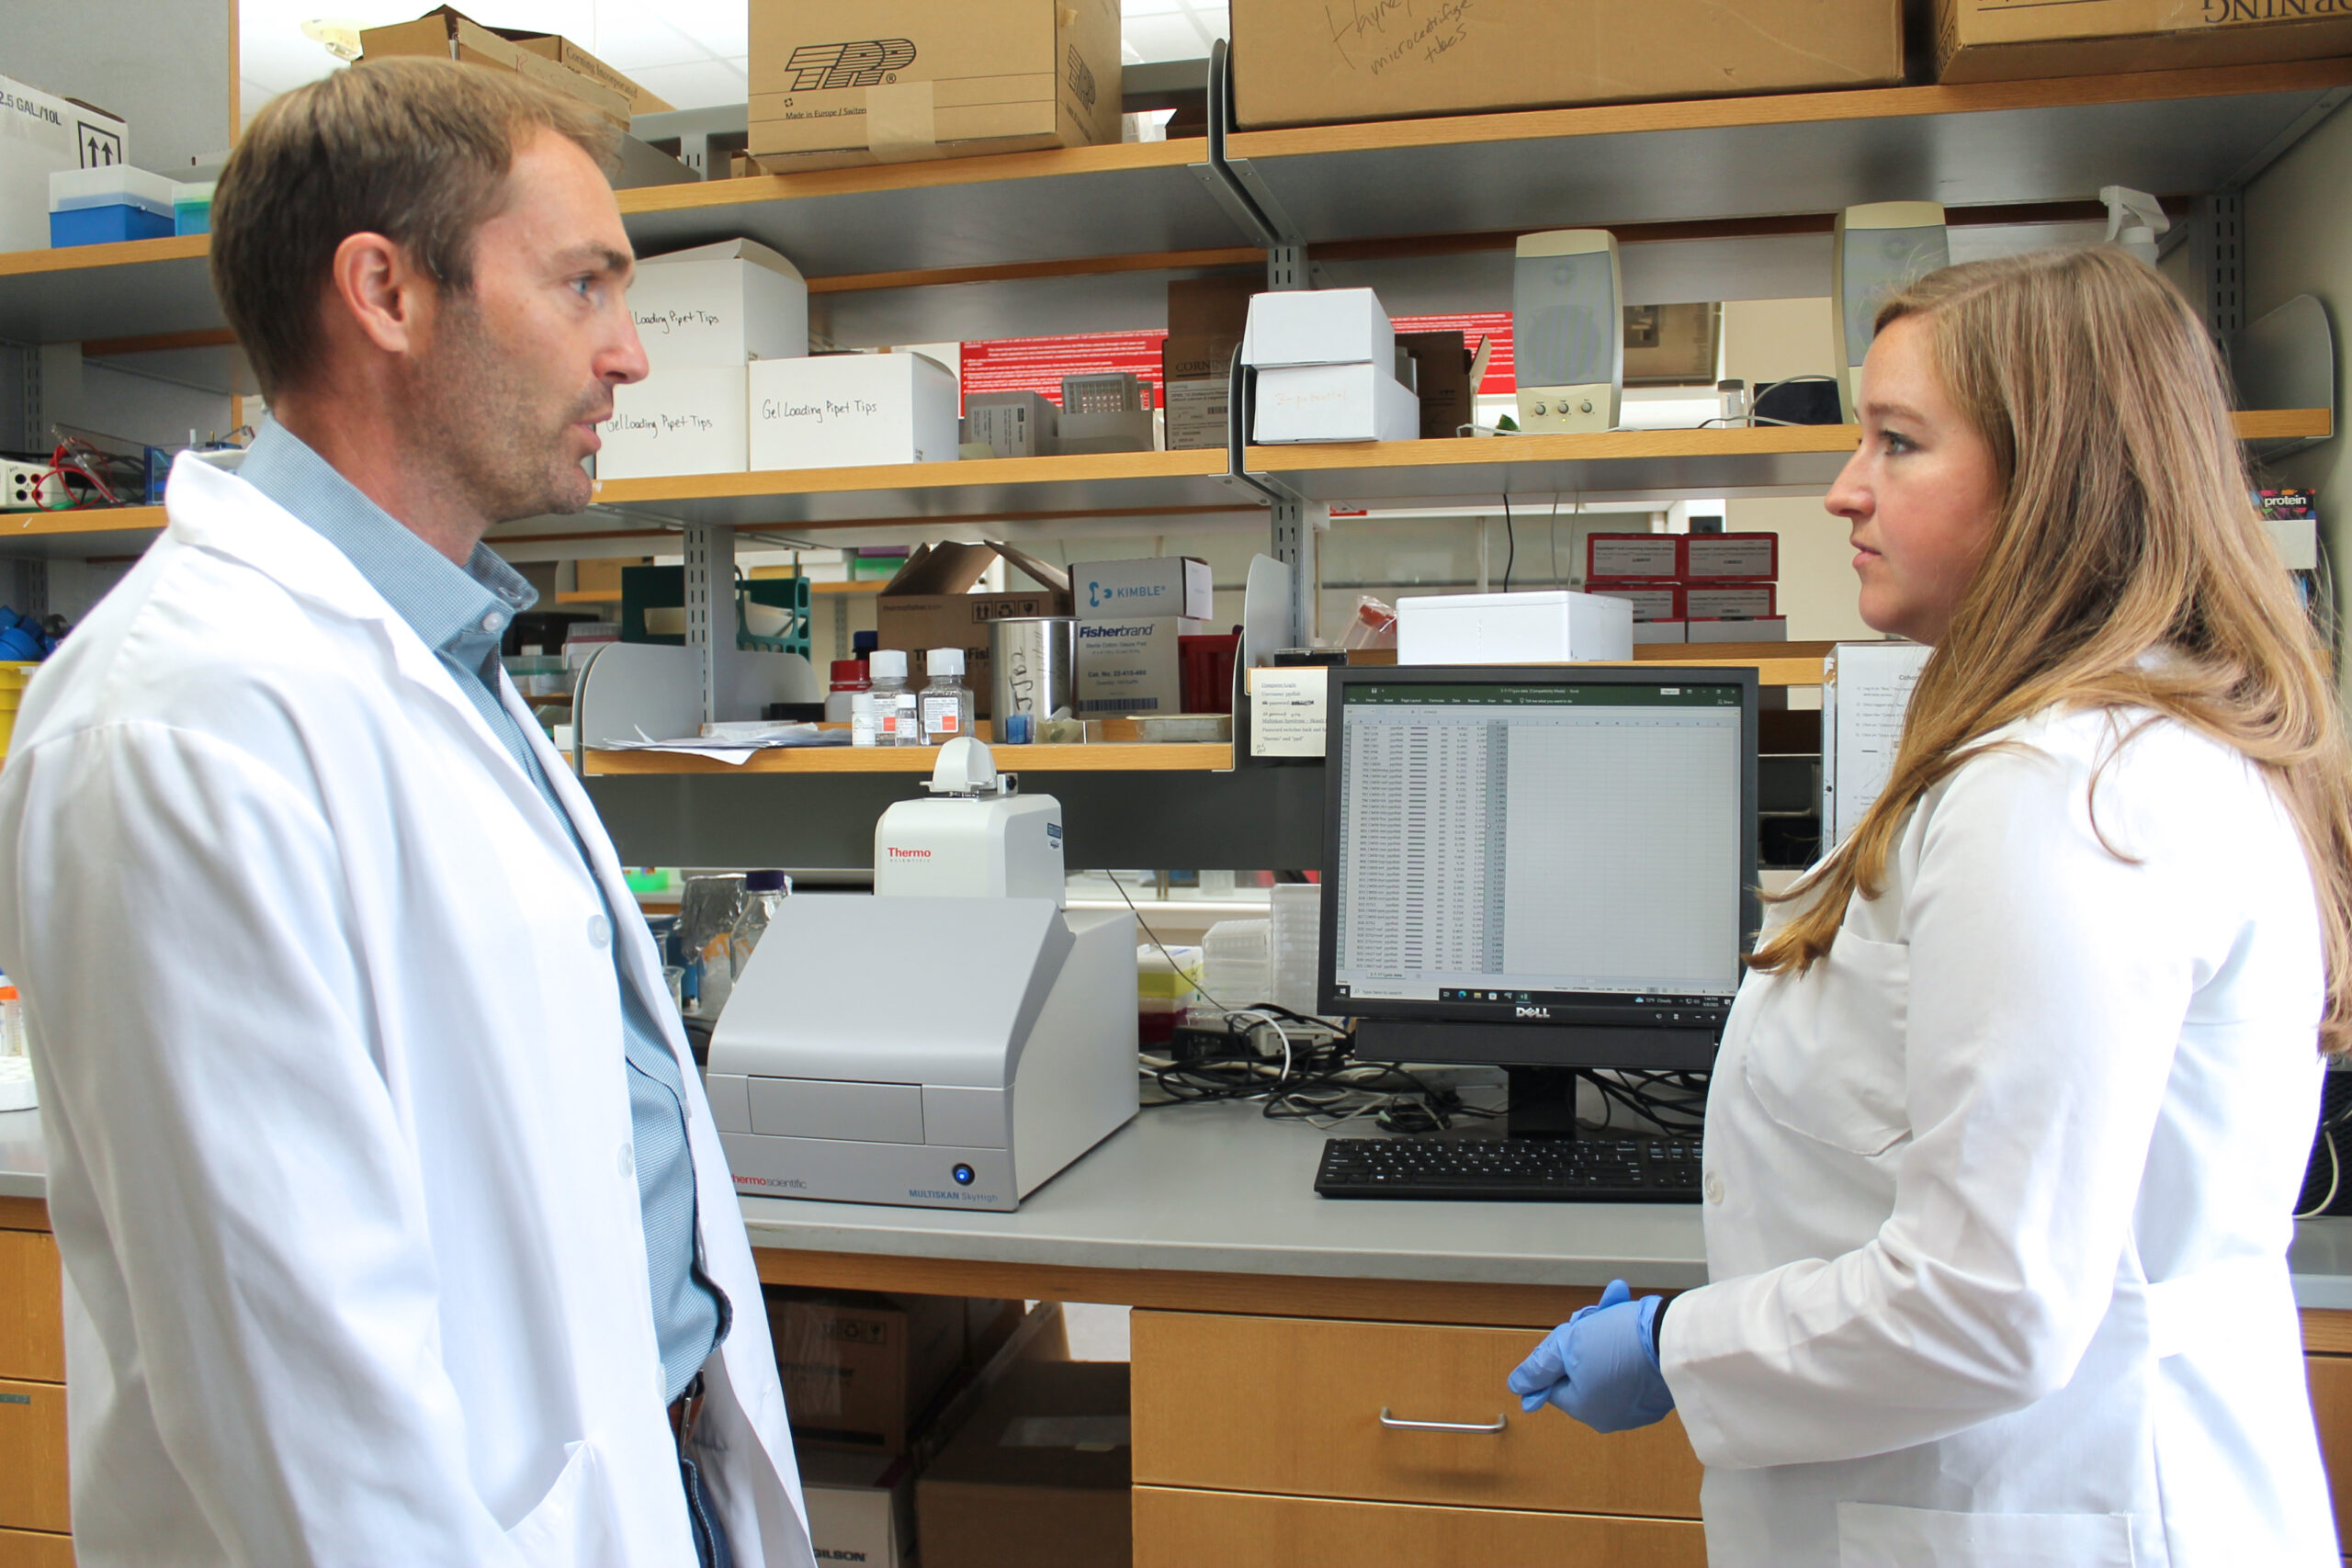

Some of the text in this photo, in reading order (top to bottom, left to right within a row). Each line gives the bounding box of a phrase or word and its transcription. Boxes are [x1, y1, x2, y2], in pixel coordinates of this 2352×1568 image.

[786, 111, 804, 119] Made
[806, 109, 813, 118] in
[814, 108, 837, 118] Europe
[634, 310, 720, 334] Loading Pipet Tips
[762, 399, 877, 423] Gel Loading Pipet Tips
[624, 413, 659, 439] Loading
[661, 413, 688, 432] Pipet
[690, 414, 714, 433] Tips
[2264, 495, 2307, 508] protein
[1079, 624, 1154, 638] Fisherbrand
[888, 846, 932, 858] Thermo
[1515, 1006, 1552, 1019] DELL
[909, 1189, 999, 1203] MULTISKAN SkyHigh
